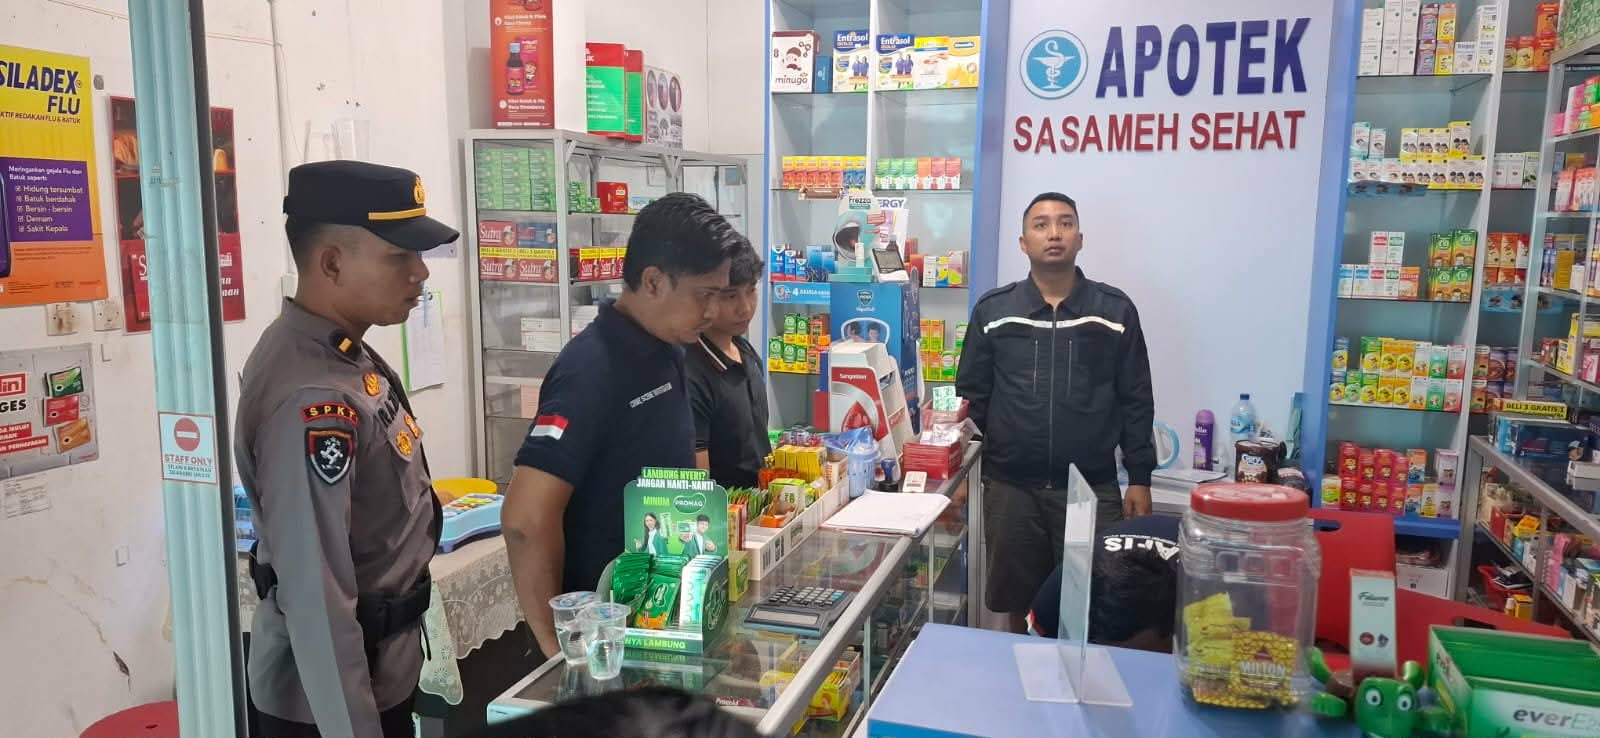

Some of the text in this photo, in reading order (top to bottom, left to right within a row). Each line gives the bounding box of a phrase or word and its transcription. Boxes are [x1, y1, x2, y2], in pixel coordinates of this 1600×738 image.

[837, 33, 868, 42] Entrasol
[880, 36, 910, 46] Entrasol
[1095, 18, 1312, 99] APOTEK
[47, 95, 81, 116] FLU
[1013, 110, 1306, 154] SASAMEH SEHAT
[23, 185, 49, 194] Hidung
[24, 195, 44, 203] Batuk
[25, 205, 47, 213] Bersin
[52, 205, 73, 213] bersin
[27, 225, 69, 234] Sakit Kepala
[480, 222, 501, 240] Sutra
[480, 259, 503, 275] Sutra
[519, 260, 541, 276] Sutra
[792, 287, 799, 296] 4
[165, 454, 213, 466] STAFF ONLY
[643, 469, 706, 480] LAMBUNG NYERI?
[636, 478, 714, 491] JANGAN NANTI-NANTI
[643, 496, 670, 506] MINUM
[643, 639, 686, 649] LAMBUNG
